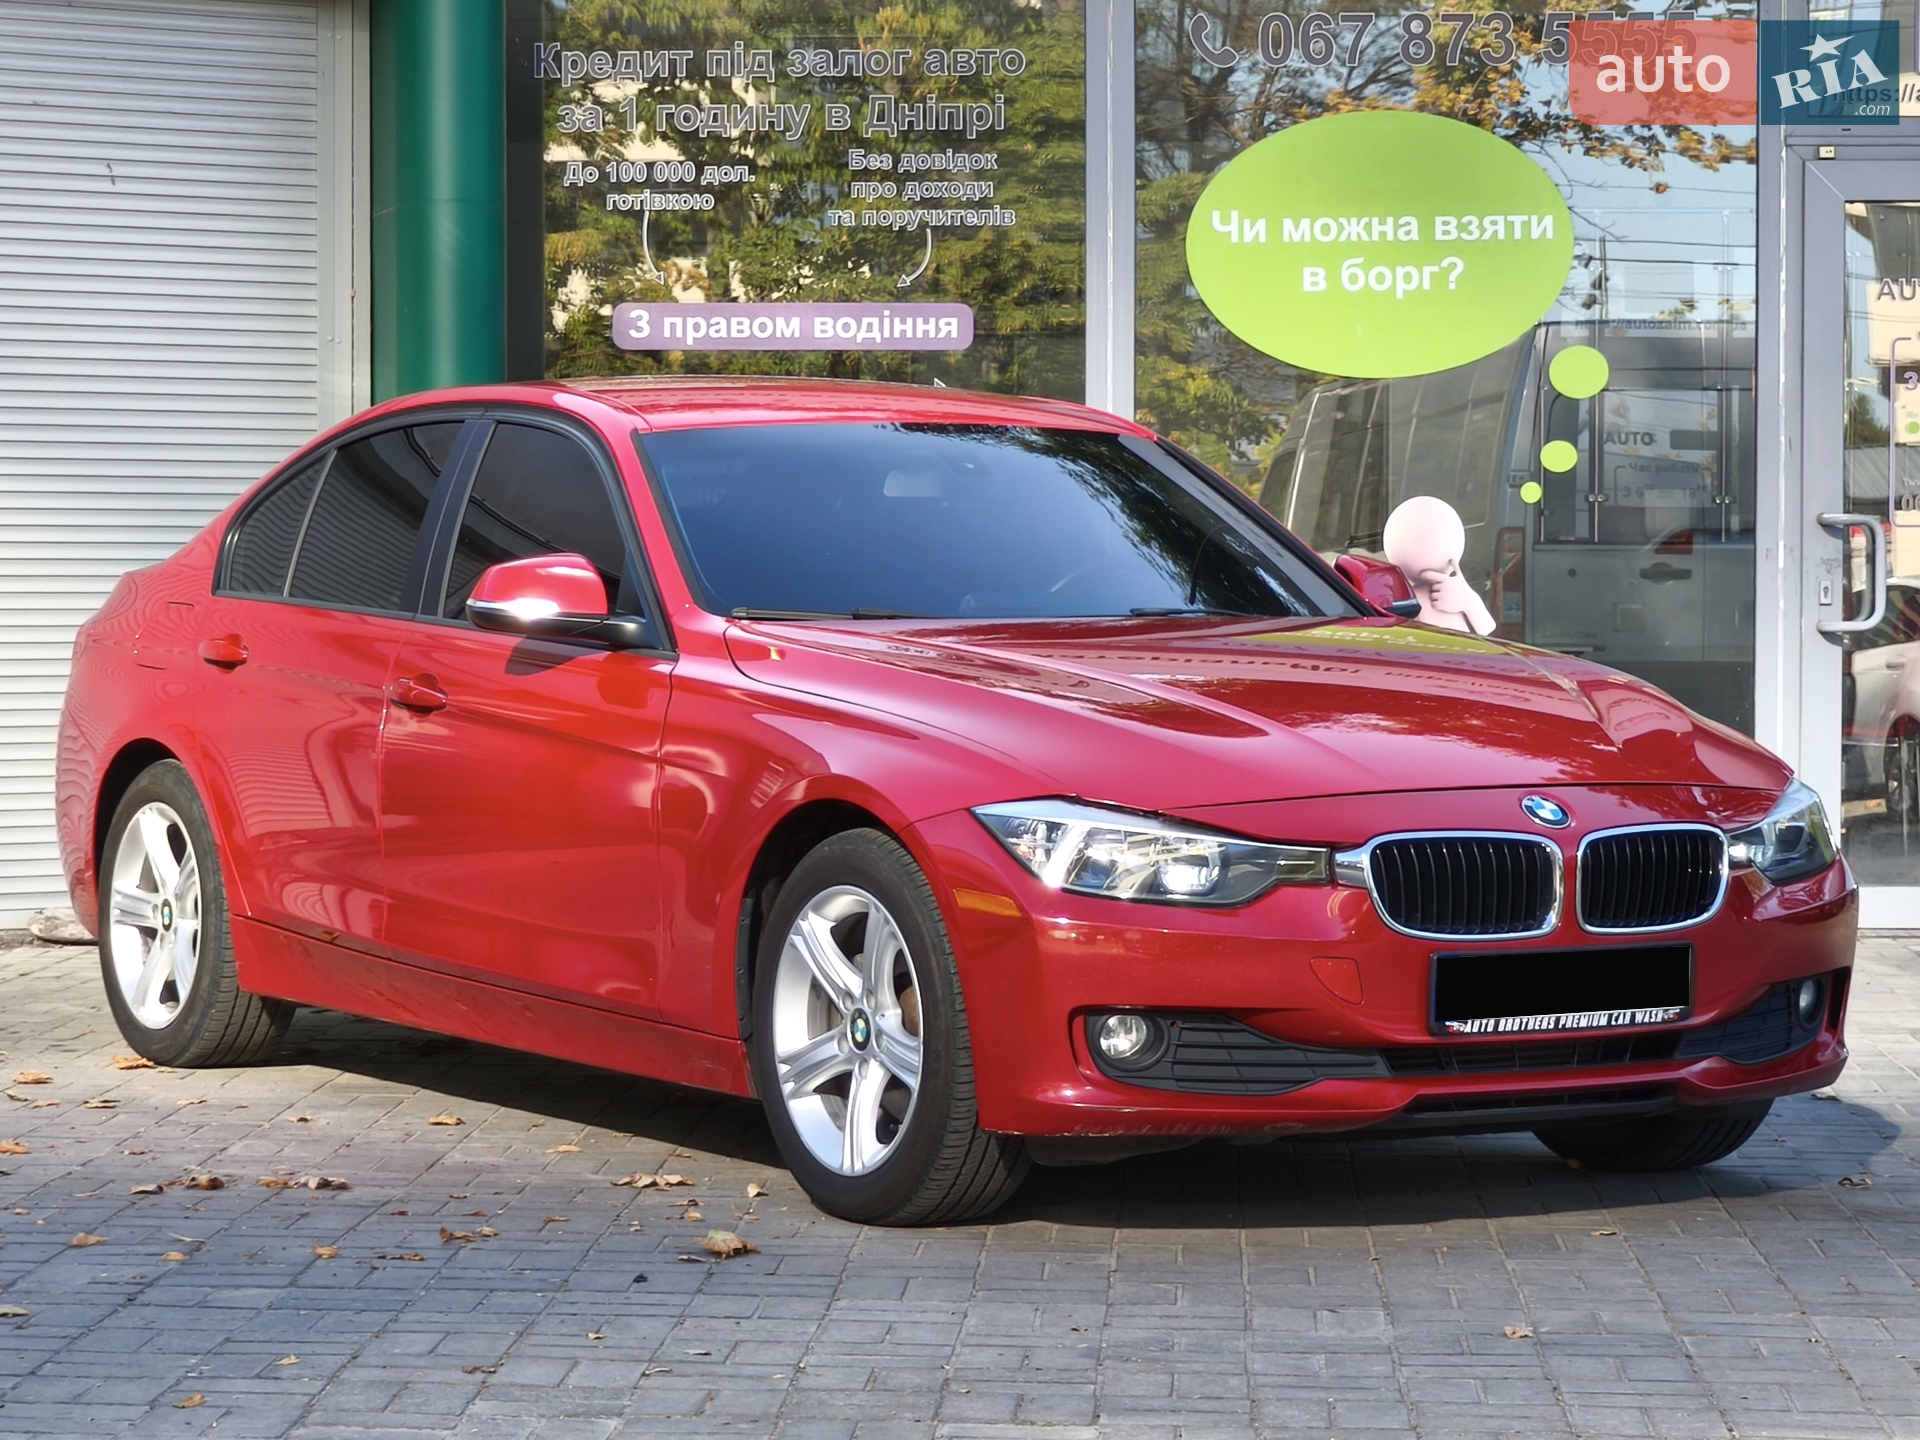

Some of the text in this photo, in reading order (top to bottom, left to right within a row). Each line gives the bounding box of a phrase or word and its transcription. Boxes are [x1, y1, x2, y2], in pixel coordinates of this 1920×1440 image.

[1258, 12, 1376, 68] 067
[1400, 12, 1517, 67] 873
[534, 40, 1027, 88] Кредит під залог авто
[556, 94, 1006, 140] за 1 годину в Дніпрі
[563, 161, 756, 187] До 100 000 дол.
[848, 148, 999, 173] Без довідок
[606, 189, 716, 211] готівкою
[850, 181, 994, 203] про доходи
[827, 205, 1017, 232] та поручителів
[1211, 209, 1555, 244] Чи можна взяти
[1302, 256, 1465, 300] в борг?
[1877, 277, 1920, 301] AU
[628, 309, 960, 345] З правом водіння
[1464, 1009, 1664, 1034] AUTO BROTHERS PREMIUM CAR WASH
